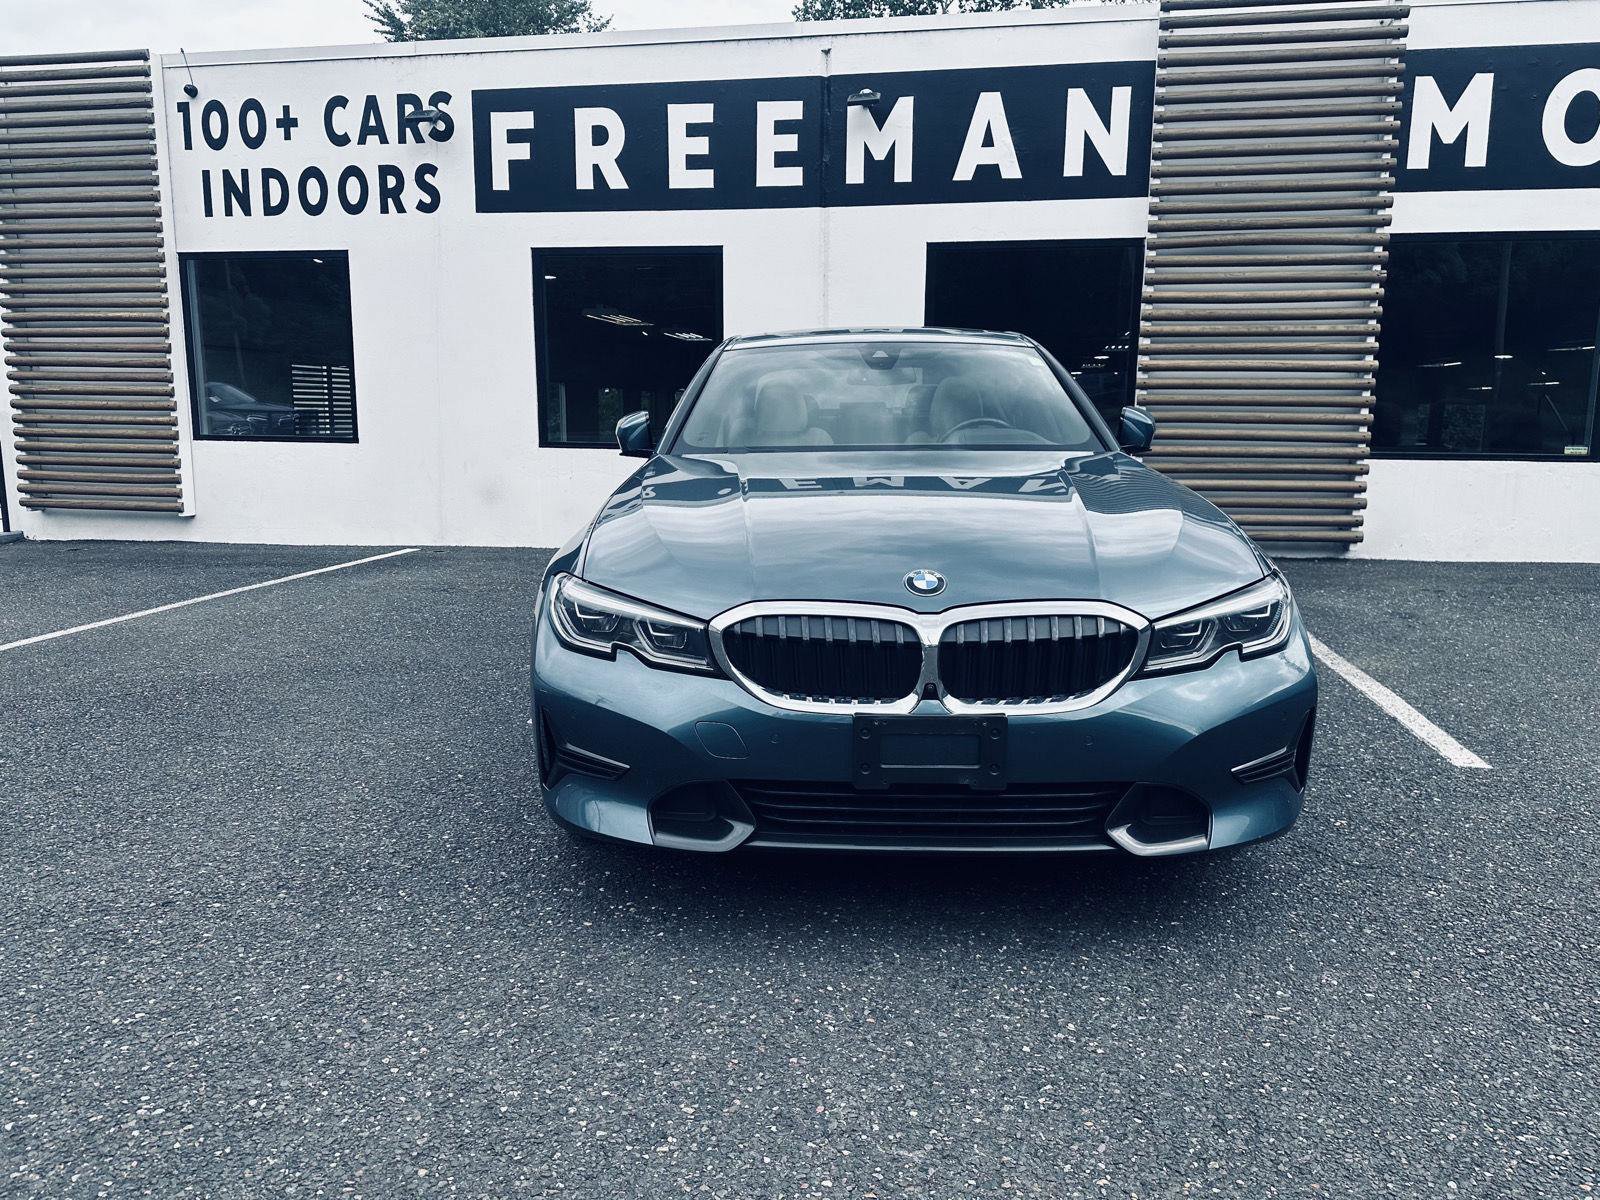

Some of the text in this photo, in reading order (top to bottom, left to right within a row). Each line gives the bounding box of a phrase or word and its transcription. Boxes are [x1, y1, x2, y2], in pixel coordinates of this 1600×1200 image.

[177, 91, 455, 151] 100+ CARS
[490, 67, 1600, 190] FREEMAN MO
[202, 163, 441, 218] INDOORS
